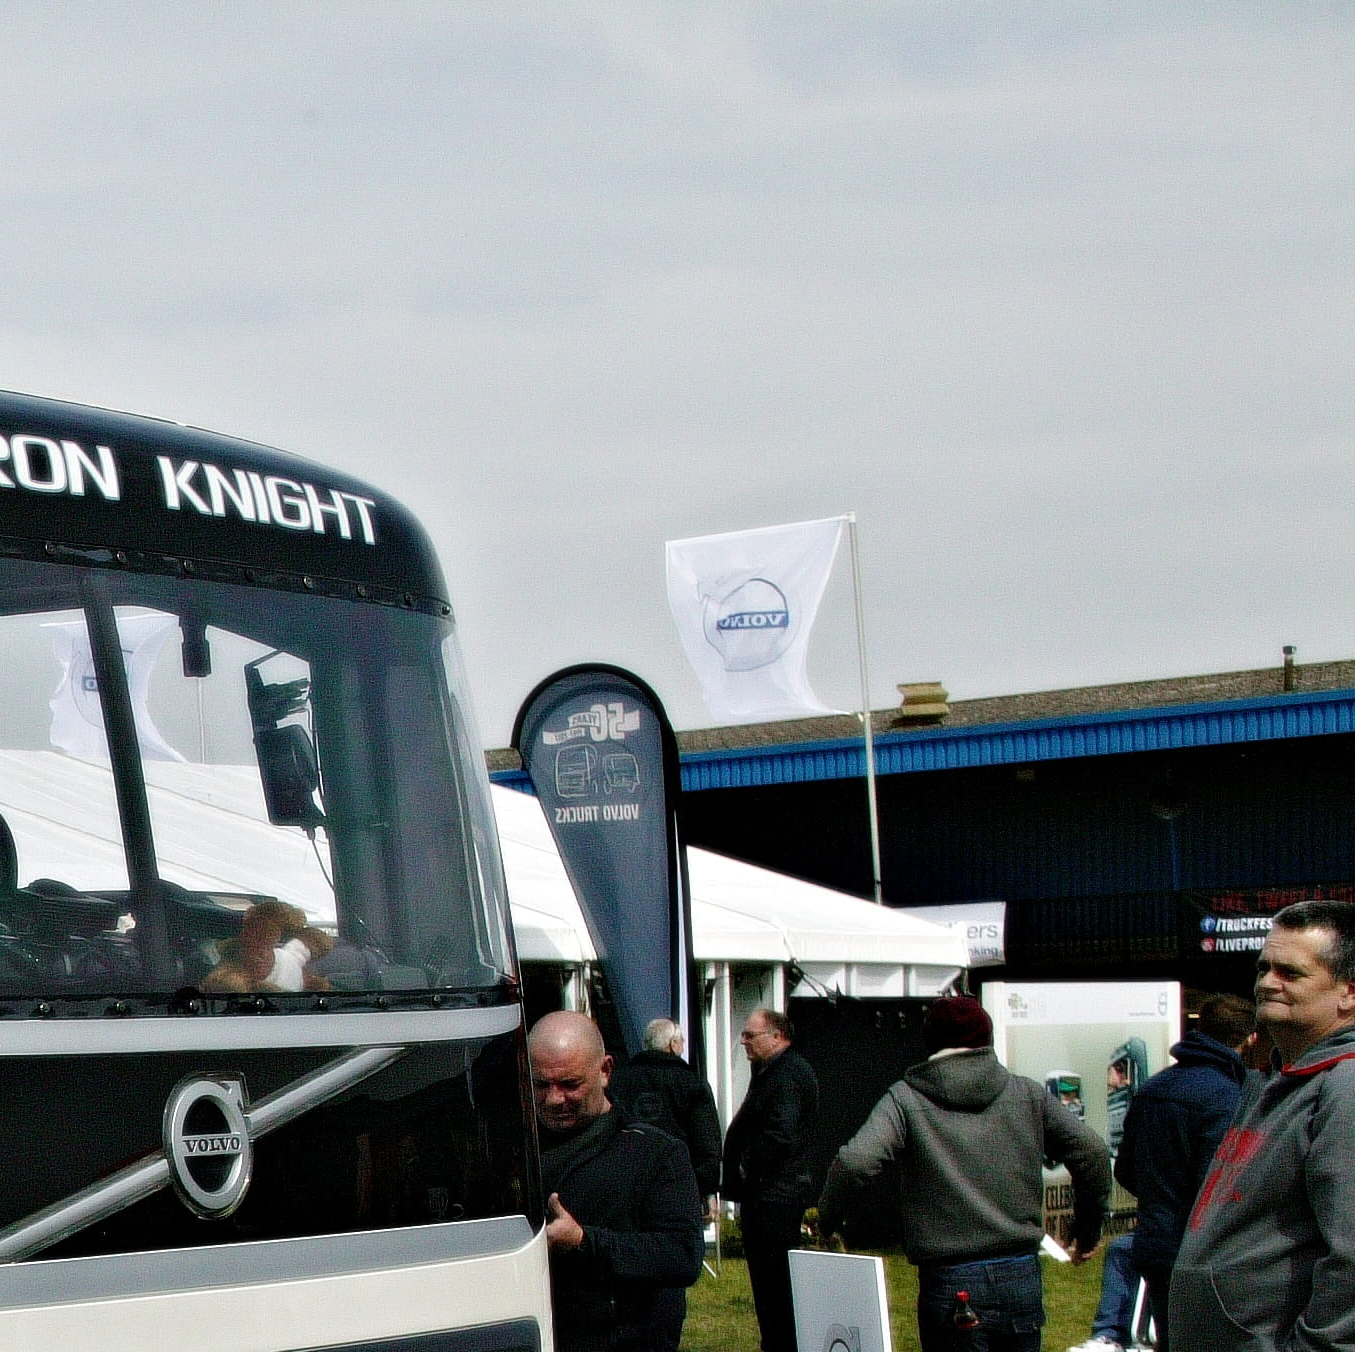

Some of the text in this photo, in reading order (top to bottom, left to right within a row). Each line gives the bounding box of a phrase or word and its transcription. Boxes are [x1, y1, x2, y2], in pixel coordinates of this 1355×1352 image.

[157, 455, 376, 546] KNIGHT
[1216, 917, 1273, 932] /TRUCKFES
[182, 1137, 240, 1153] VOLVO
